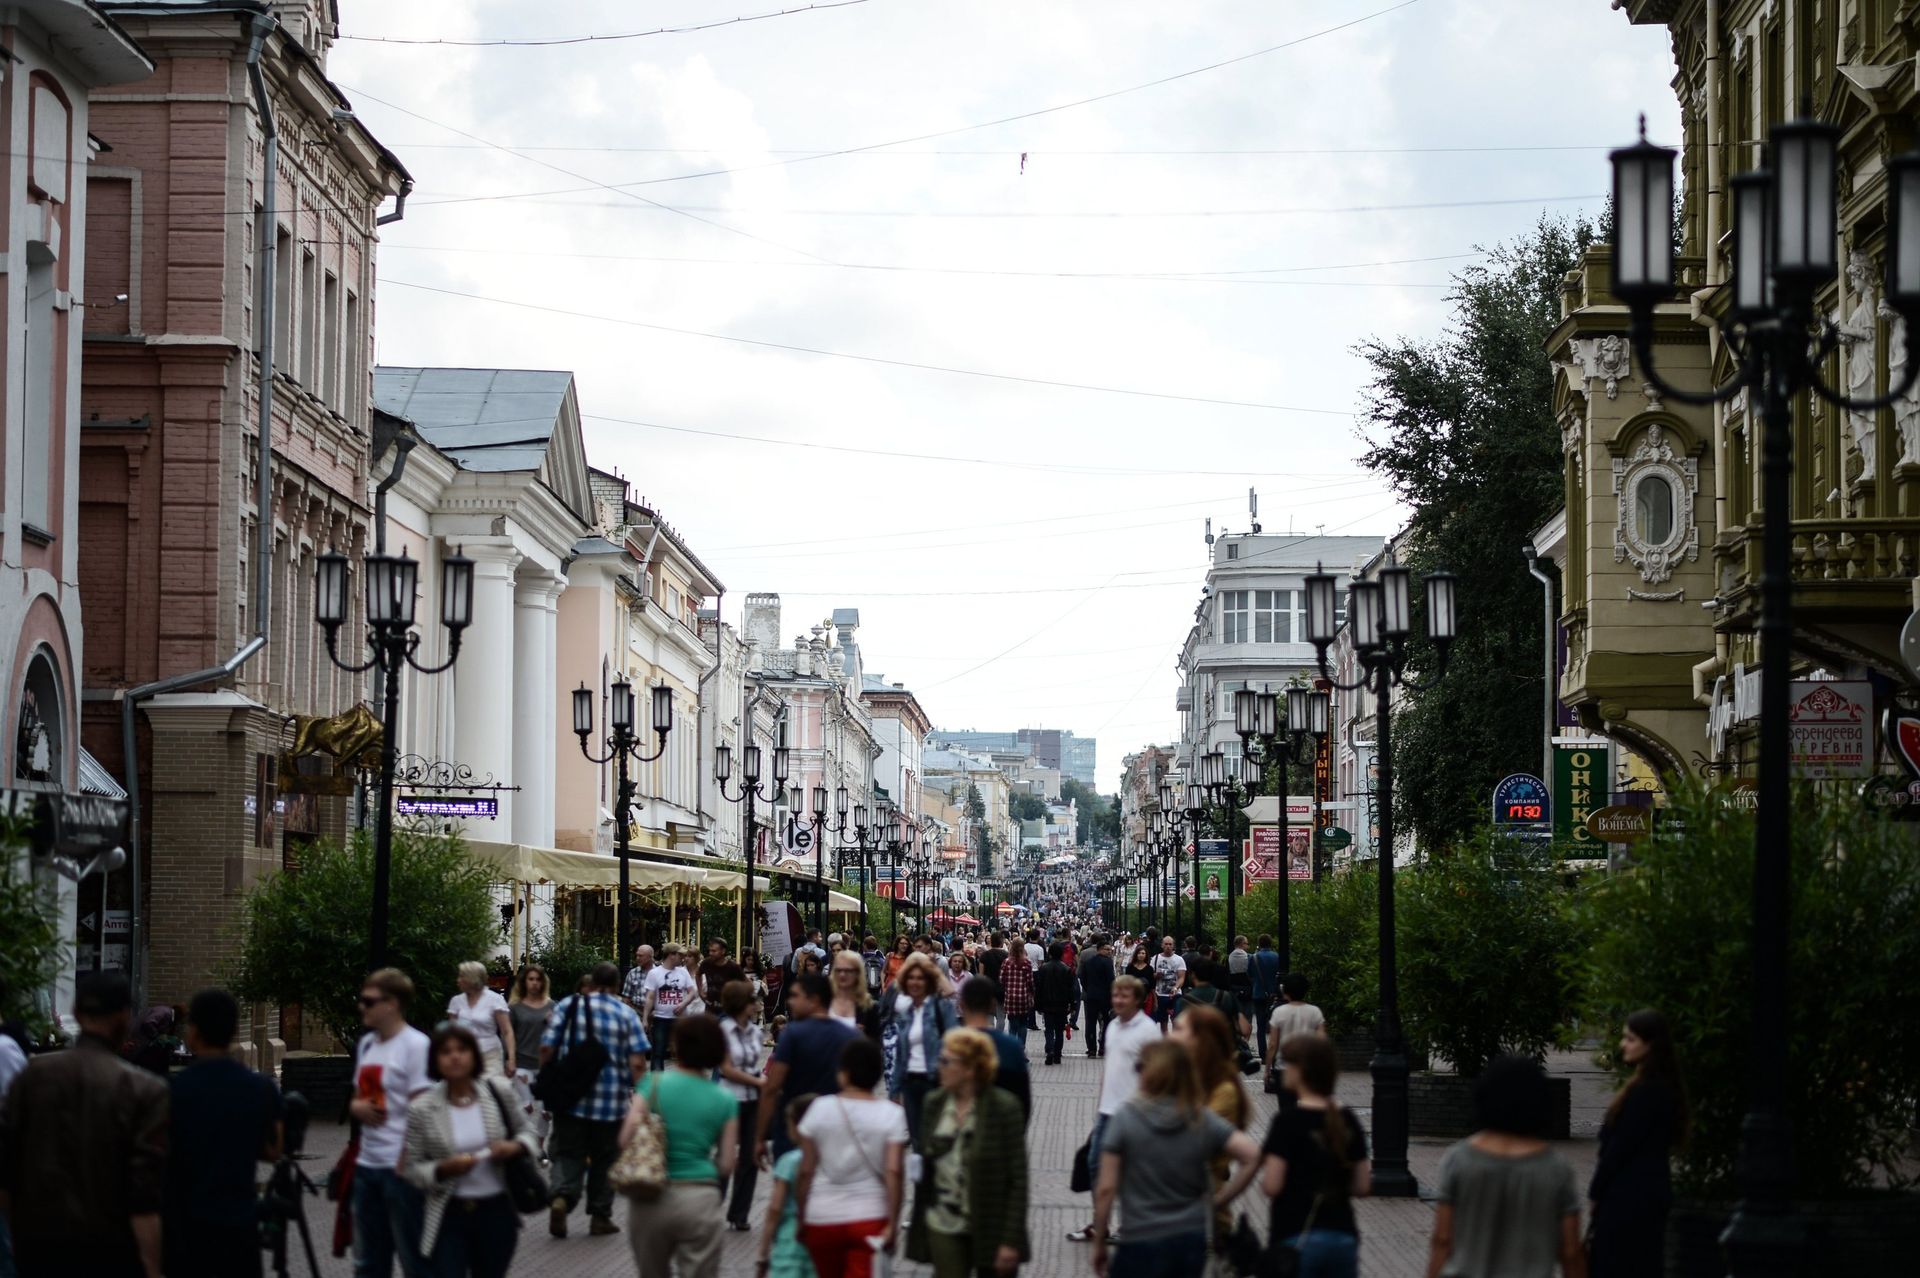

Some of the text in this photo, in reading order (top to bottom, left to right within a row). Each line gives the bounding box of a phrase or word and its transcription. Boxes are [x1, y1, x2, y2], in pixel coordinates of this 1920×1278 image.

[1499, 777, 1546, 798] ТУРИСТИЧЕСКАЯ
[1570, 752, 1592, 842] ОНИКС
[1598, 816, 1647, 831] BOHEMIA
[788, 817, 812, 849] le
[104, 919, 131, 929] Апте
[658, 990, 683, 999] ВСЕ
